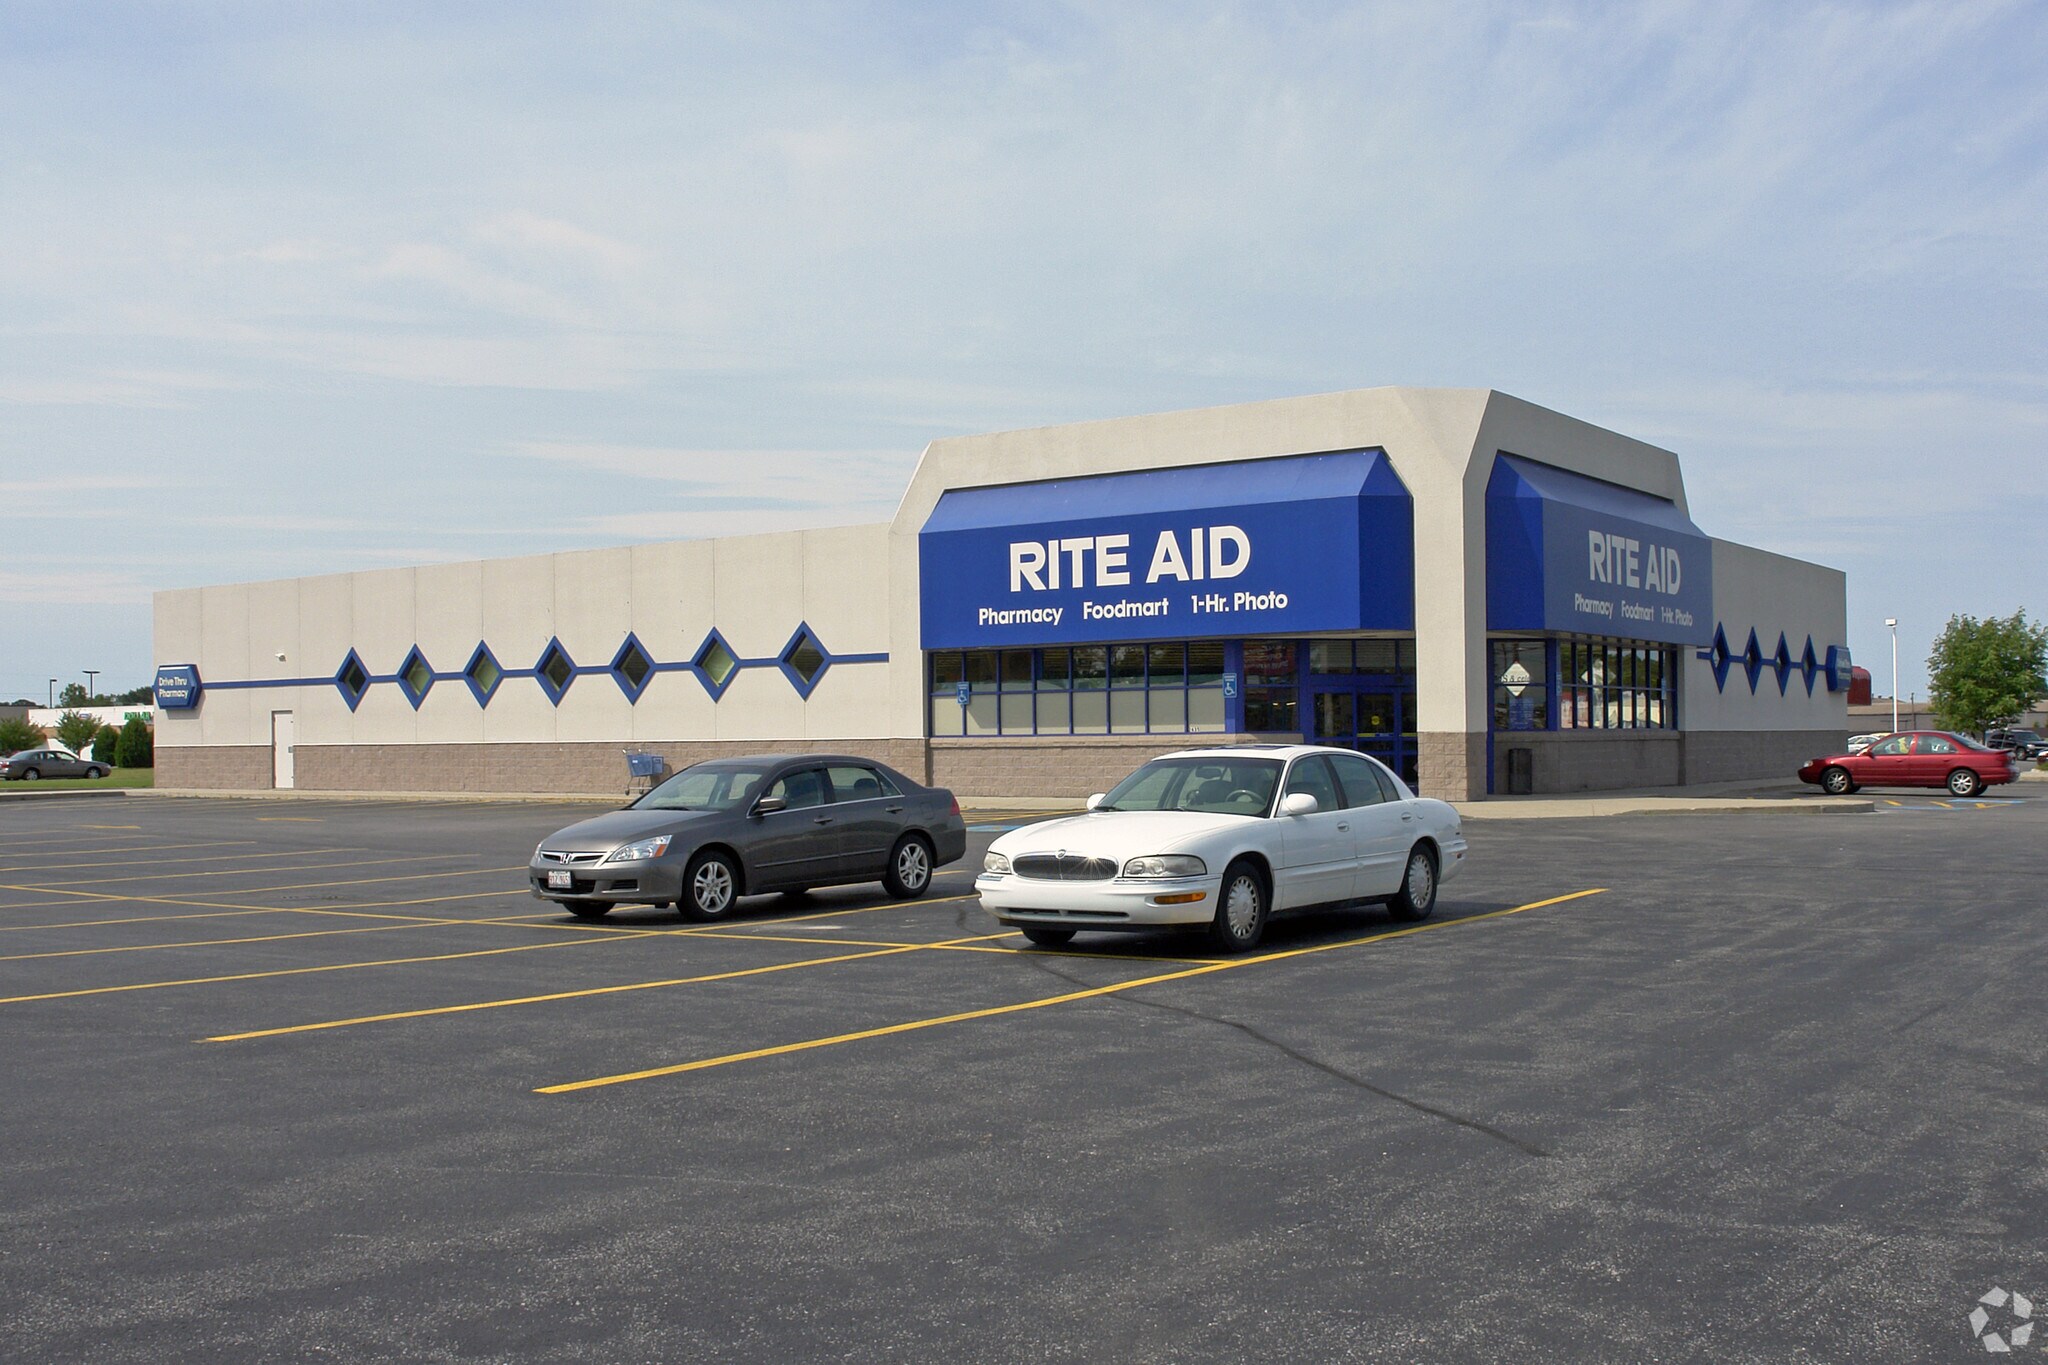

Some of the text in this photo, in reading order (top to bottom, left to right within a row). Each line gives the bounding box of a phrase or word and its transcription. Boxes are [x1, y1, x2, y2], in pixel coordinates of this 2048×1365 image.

[1009, 525, 1251, 592] RITE AID
[1588, 529, 1682, 596] RITE AID
[978, 590, 1288, 626] Pharmacy Foodmart 1-Hr. Photo
[1574, 592, 1614, 620] Pharmacy
[1621, 600, 1654, 622] Foodmart
[1675, 608, 1693, 627] Photo
[158, 676, 187, 687] Drive Thru
[158, 689, 188, 699] Pharmacy
